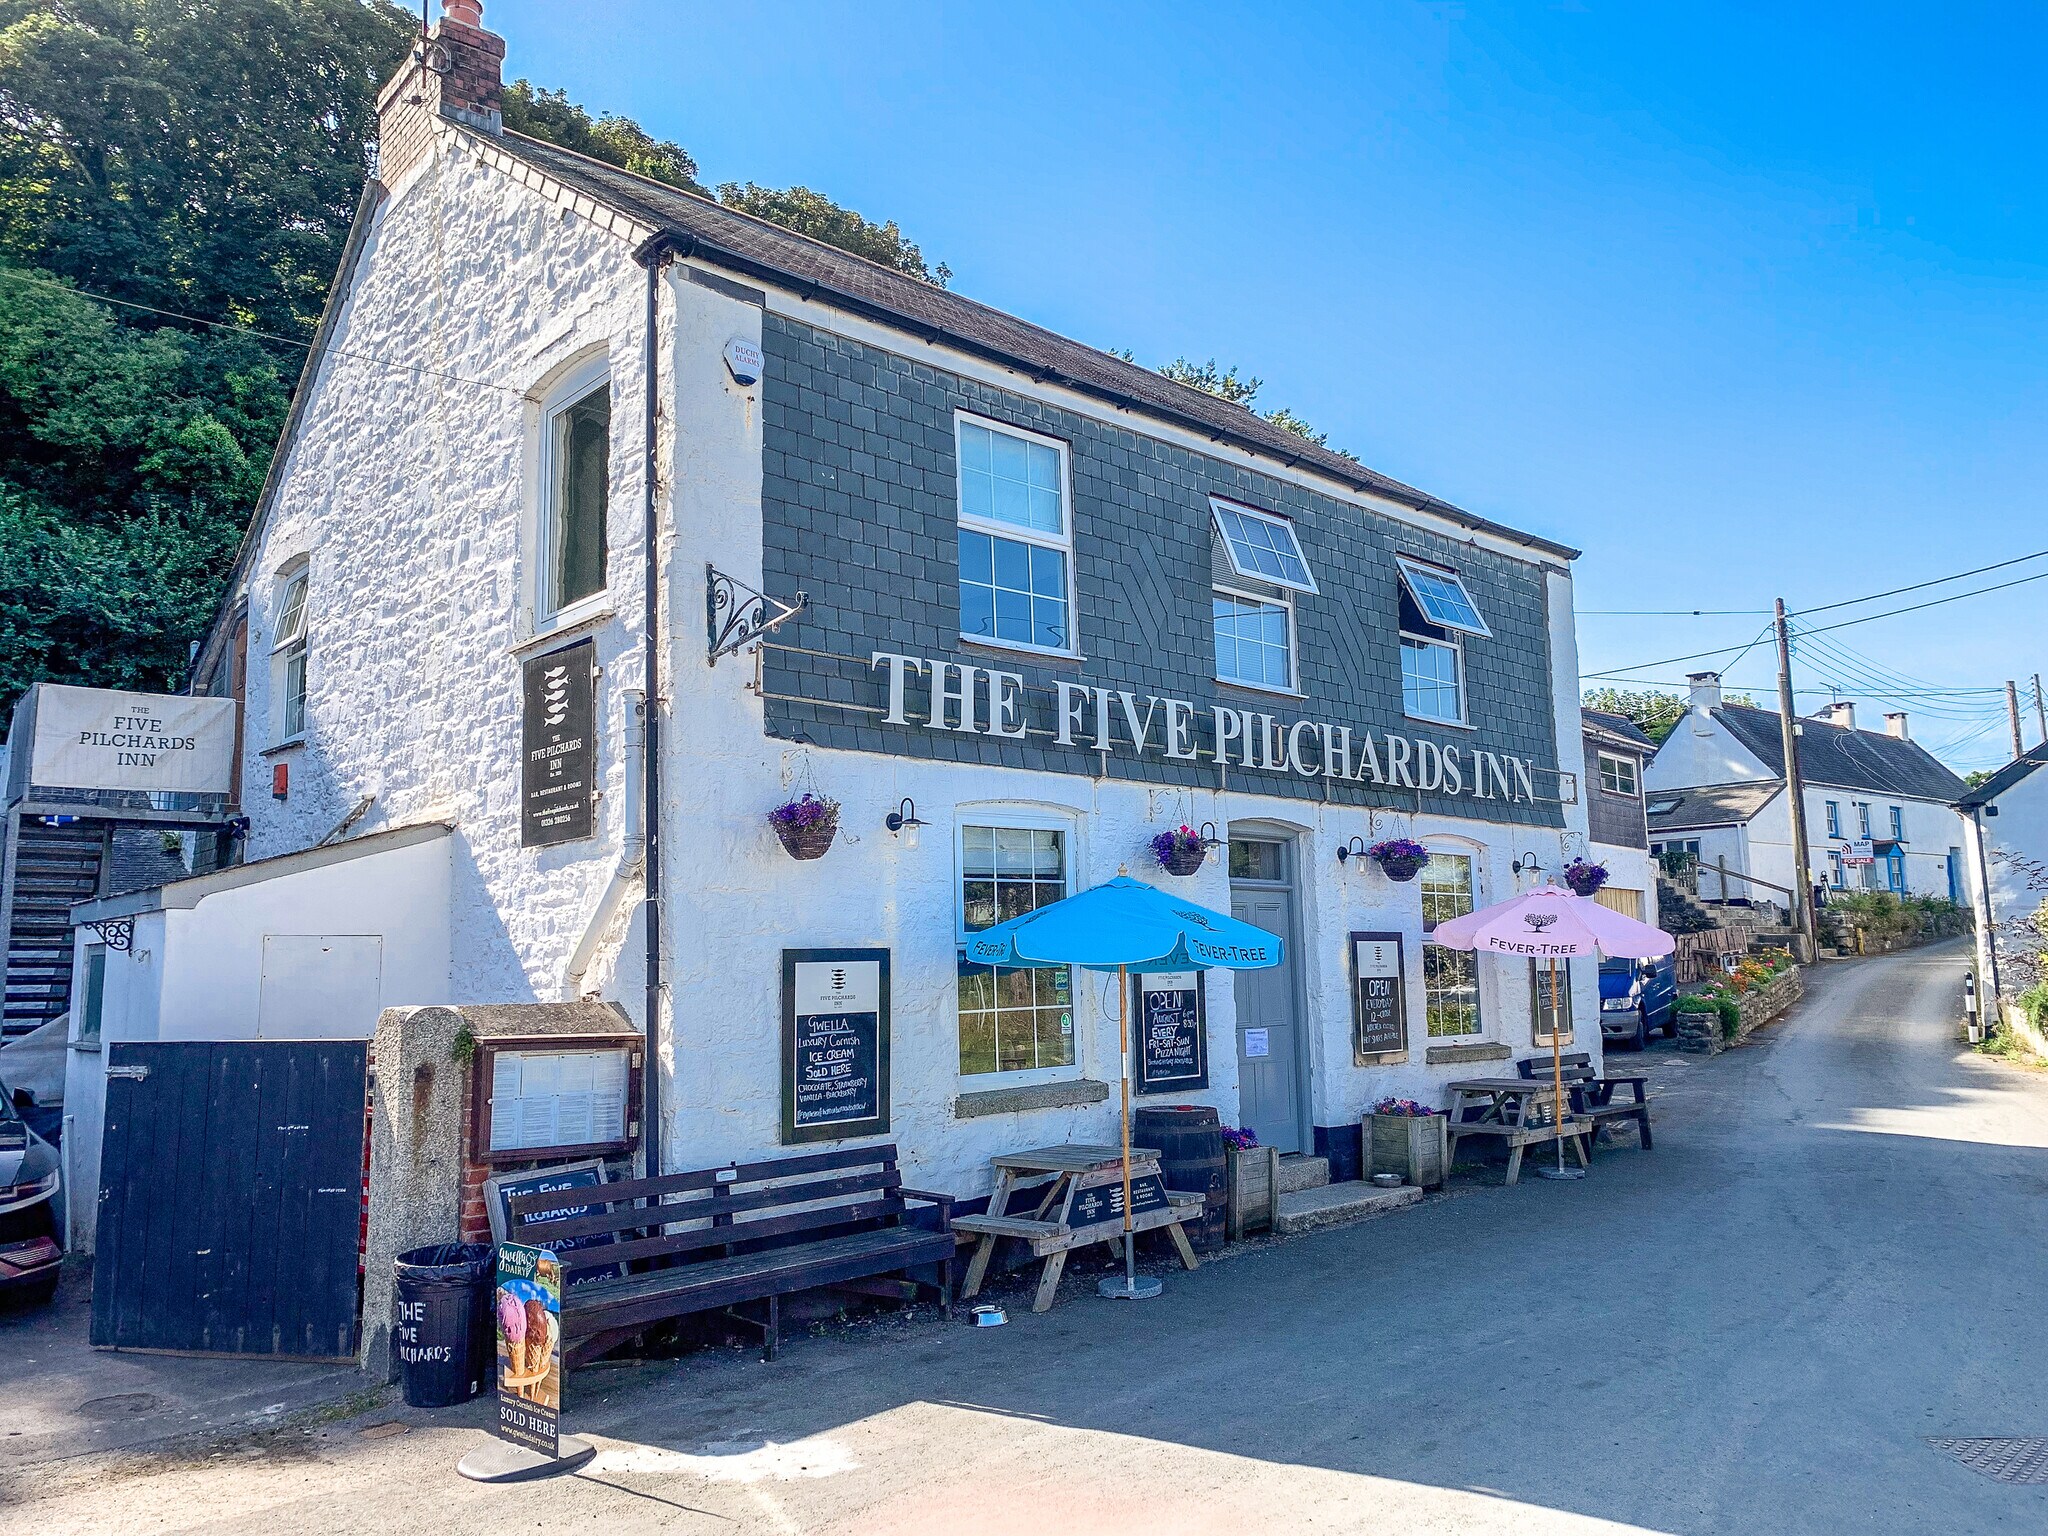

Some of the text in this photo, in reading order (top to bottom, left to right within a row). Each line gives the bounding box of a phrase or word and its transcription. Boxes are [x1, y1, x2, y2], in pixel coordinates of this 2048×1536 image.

[735, 354, 760, 368] ALARMS
[131, 706, 150, 714] THE
[113, 716, 162, 733] FIVE
[871, 651, 1535, 806] THE FIVE PILCHARDS INN
[78, 731, 196, 751] PILCHARDS
[531, 738, 582, 762] FIVE PILCHARDS
[117, 752, 157, 767] INN
[549, 758, 563, 771] INN
[1192, 939, 1268, 962] FEVER-TREE
[1490, 936, 1578, 955] FEVER-TREE
[1368, 979, 1391, 997] OPEN
[807, 1015, 850, 1033] GWELLA
[1153, 1012, 1180, 1025] AUGUST
[1151, 1026, 1178, 1038] EVERY
[1155, 1044, 1193, 1059] PIZZA NIGHT
[831, 1063, 853, 1077] HERE
[1078, 1200, 1103, 1211] PILCHARDS
[505, 1264, 527, 1277] DAIRY
[398, 1301, 426, 1322] THE
[500, 1394, 556, 1420] Luxury Cornish Ice Cream
[500, 1406, 556, 1438] SOLD HERE
